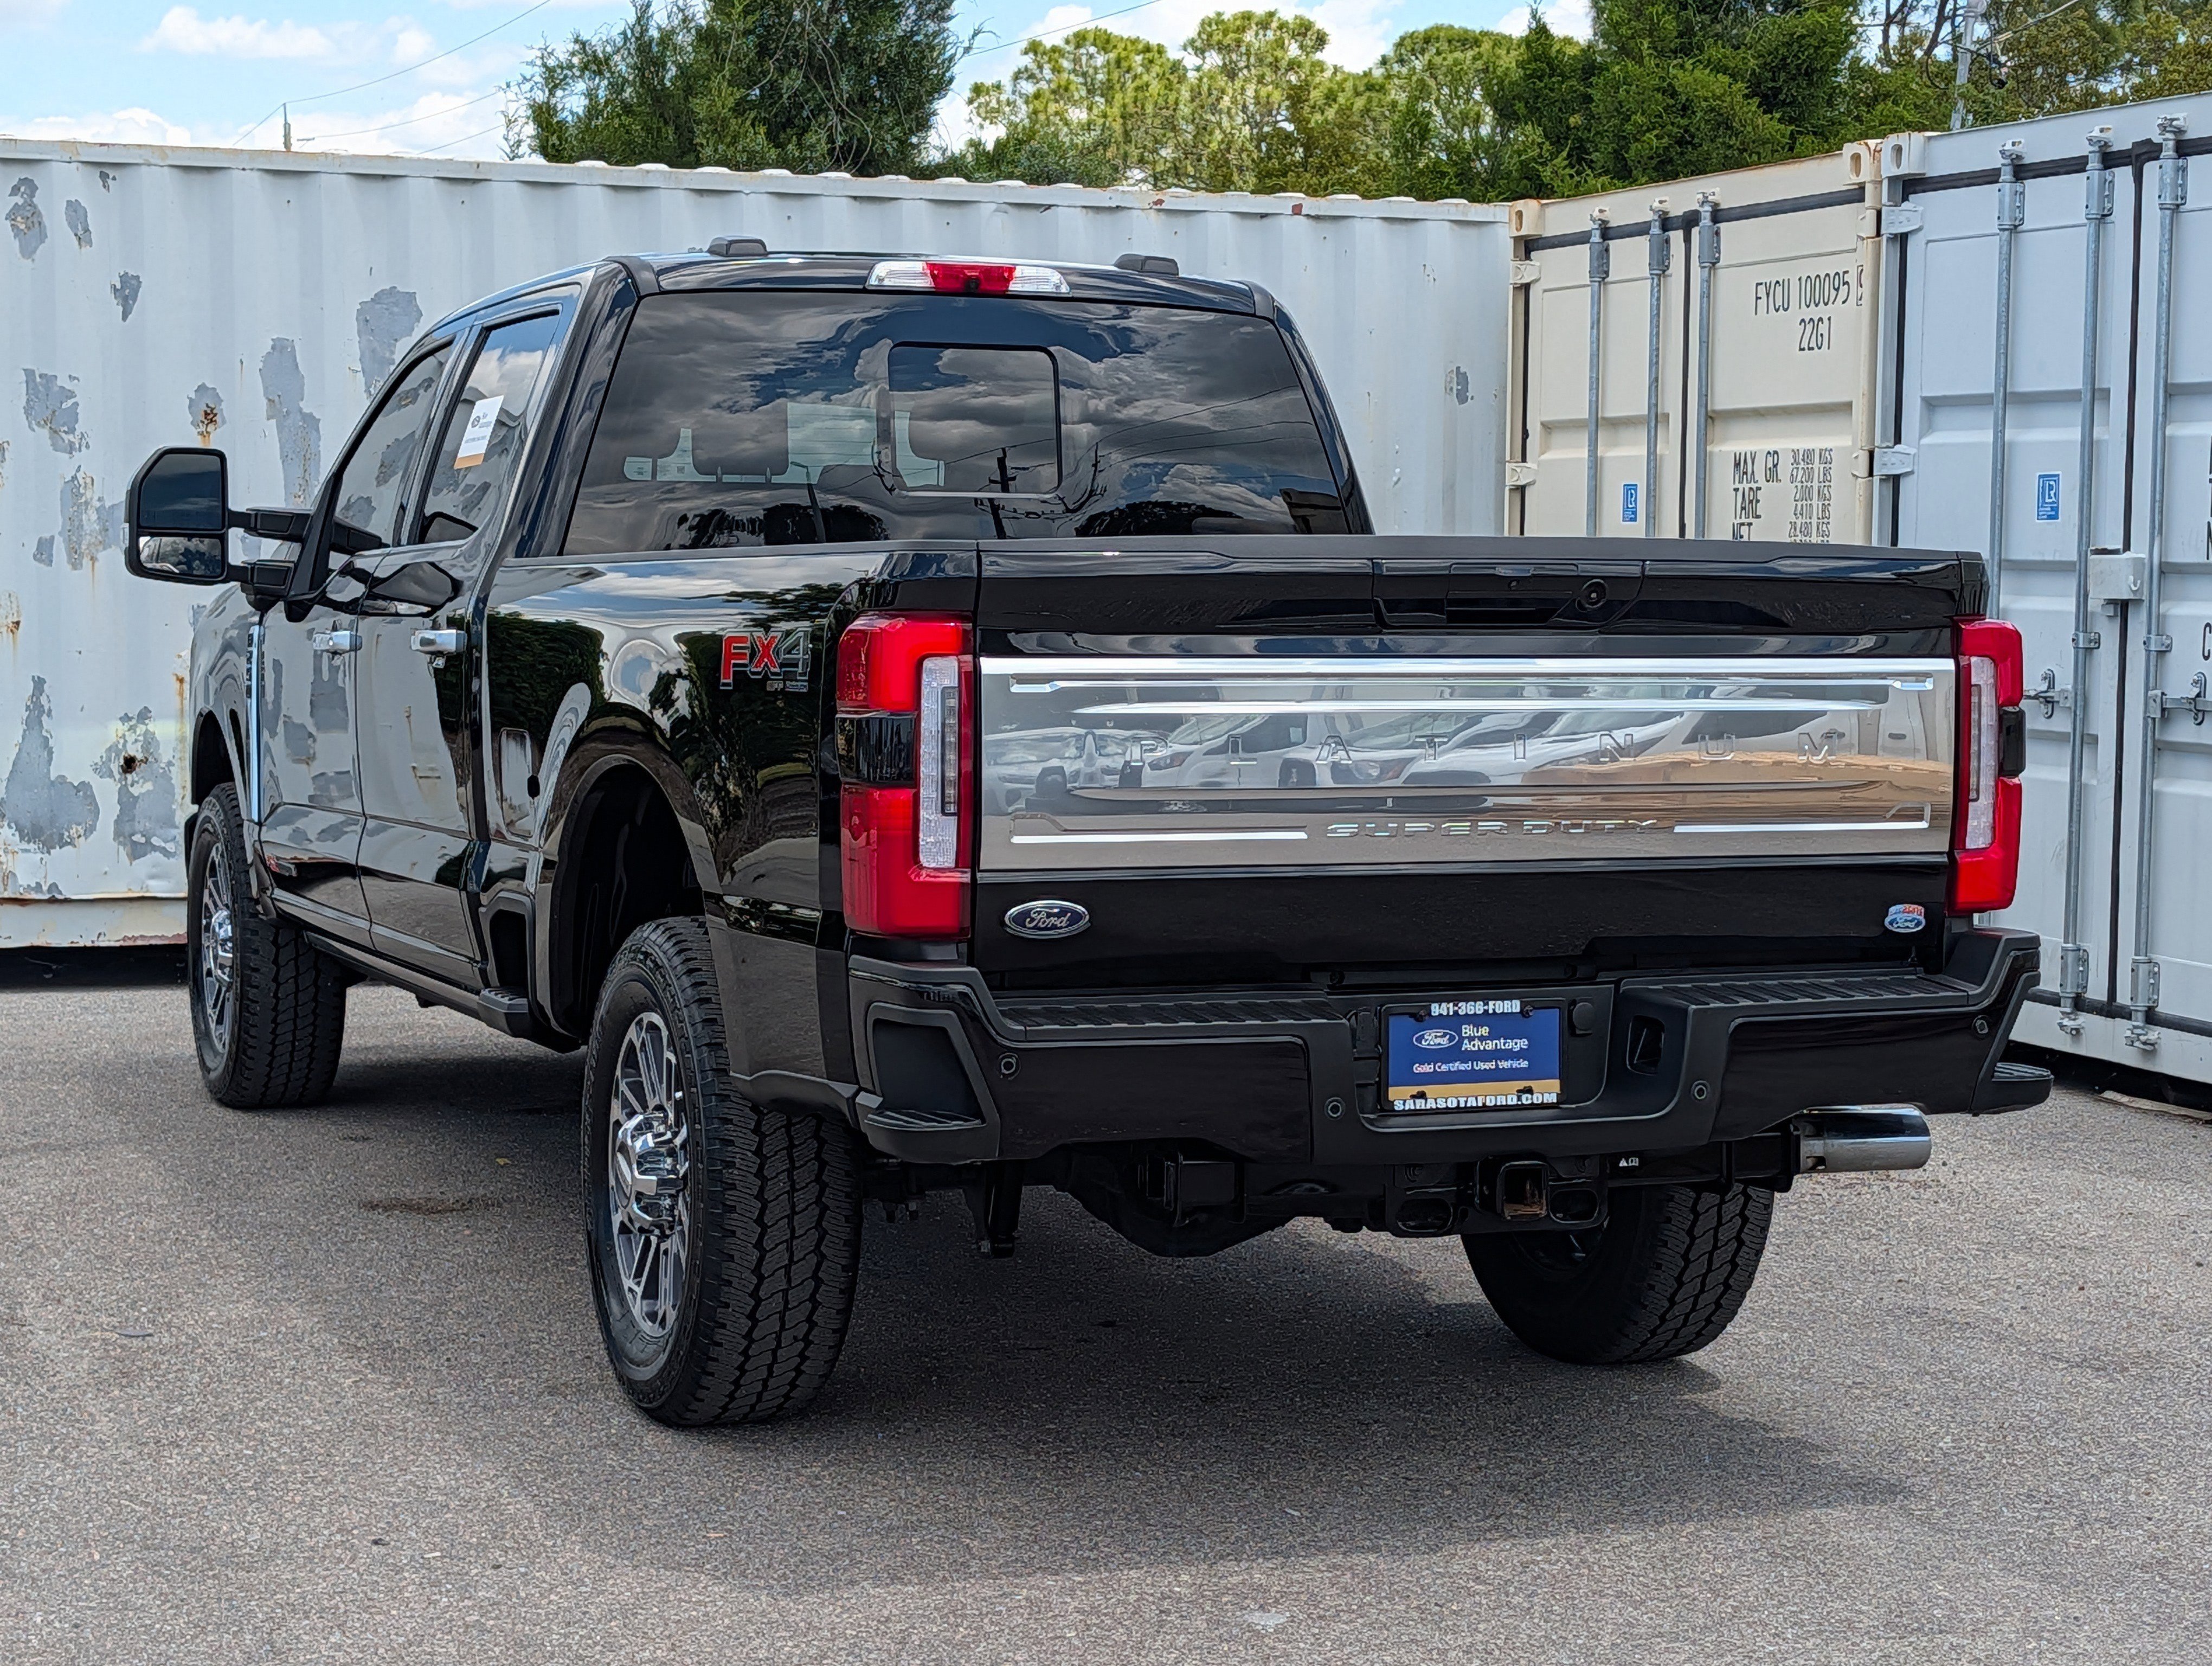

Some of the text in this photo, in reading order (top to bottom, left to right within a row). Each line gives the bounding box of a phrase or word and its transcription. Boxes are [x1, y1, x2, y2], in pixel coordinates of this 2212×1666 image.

[1754, 278, 1791, 315] FYCU
[1798, 270, 1851, 310] 100095
[1798, 316, 1831, 351] 22G1
[1765, 450, 1782, 483] GR.
[1818, 448, 1832, 465] KGS
[1817, 466, 1832, 483] LBS
[1733, 486, 1761, 520] TARE
[1817, 503, 1831, 520] LBS
[719, 627, 813, 689] FX4
[1326, 819, 1657, 837] SUPER DUTY
[1025, 907, 1070, 928] Ford
[1431, 999, 1520, 1016] 941-366-FORD
[1422, 1031, 1450, 1045] Ford
[1462, 1024, 1489, 1036] Blue
[1462, 1037, 1528, 1051] Advantage
[1413, 1058, 1529, 1073] Gold Certified Used Vehicle
[1393, 1092, 1557, 1111] SARASOTAFORD.COM
